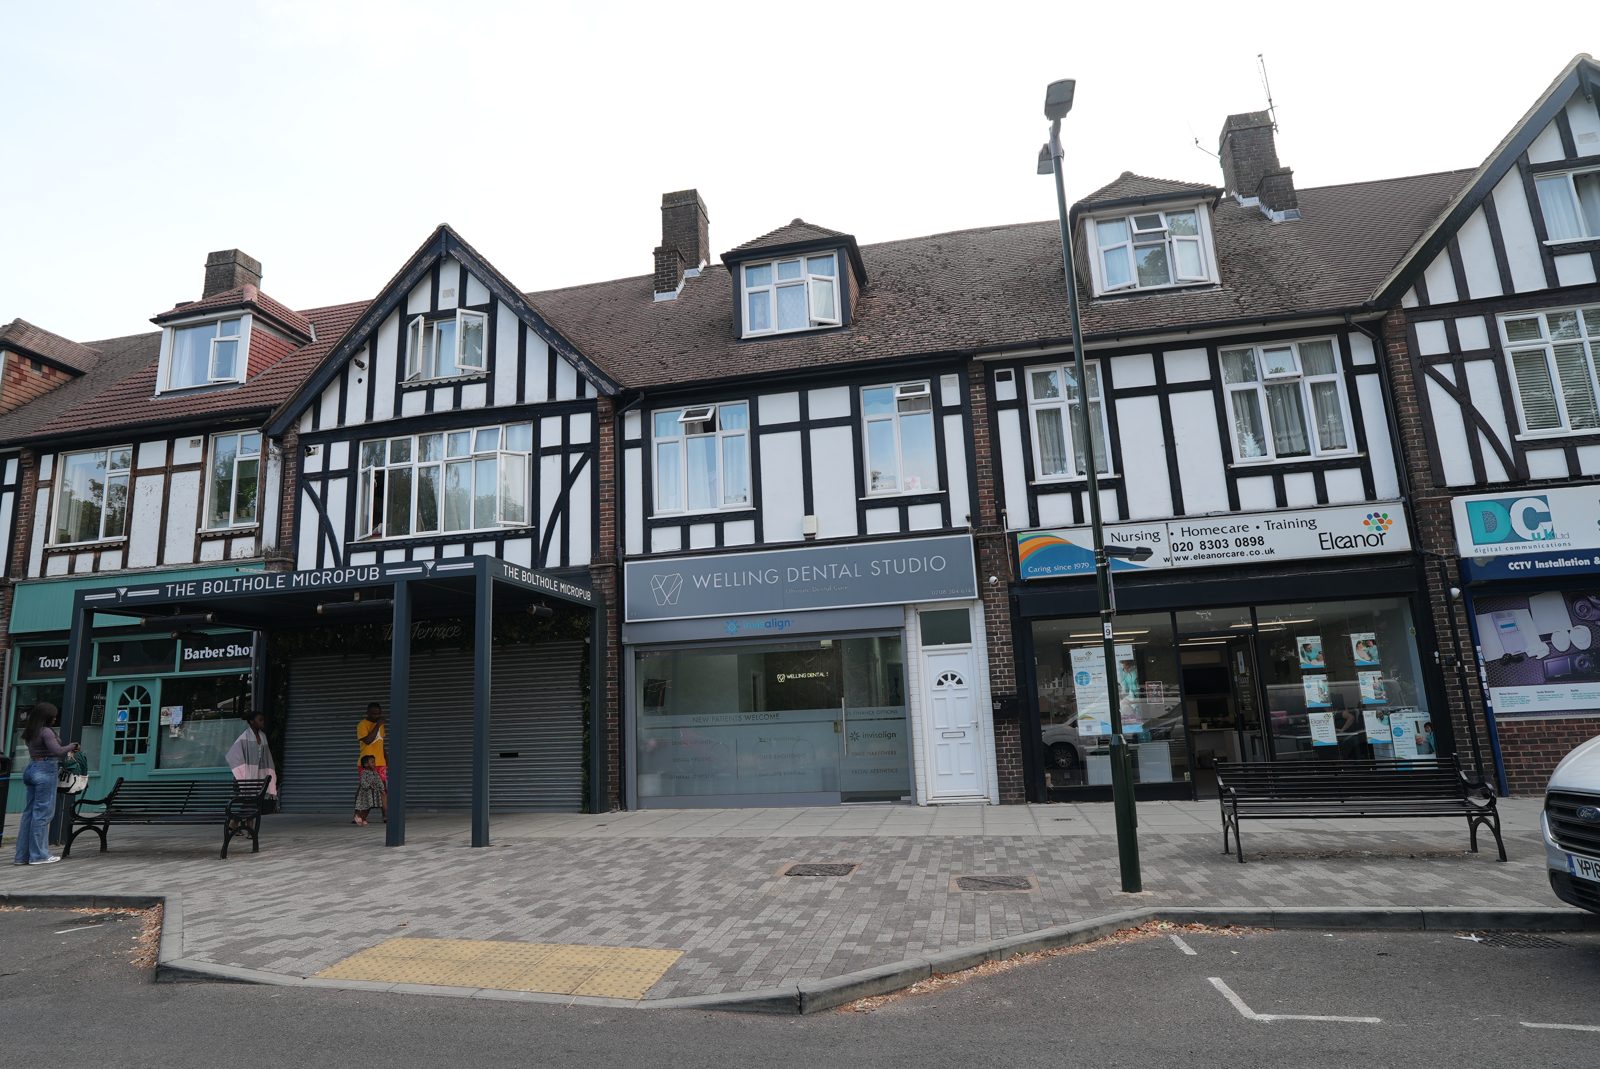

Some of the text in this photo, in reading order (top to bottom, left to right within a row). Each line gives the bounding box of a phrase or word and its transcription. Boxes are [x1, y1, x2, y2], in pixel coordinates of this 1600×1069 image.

[1110, 518, 1318, 543] Nursing Homecare Training
[1172, 536, 1265, 553] 020 8303 0898
[1319, 532, 1386, 550] Eleanor
[1474, 541, 1571, 555] digital communications
[1163, 547, 1275, 564] www.eleanorcare.co.uk
[1028, 565, 1052, 574] Caring
[1508, 561, 1532, 571] CCTV
[1535, 557, 1591, 569] Installation
[692, 555, 946, 589] WELLING DENTAL STUDIO
[166, 567, 380, 597] THE BOLTHOLE MICROPUB
[503, 564, 592, 601] THE BOLTHOLE MICROPUB
[1105, 628, 1111, 636] 9
[113, 654, 121, 662] 13
[184, 647, 225, 660] Barber
[39, 656, 68, 670] Tony'
[744, 712, 780, 721] WELCOME
[862, 731, 897, 741] invisalign
